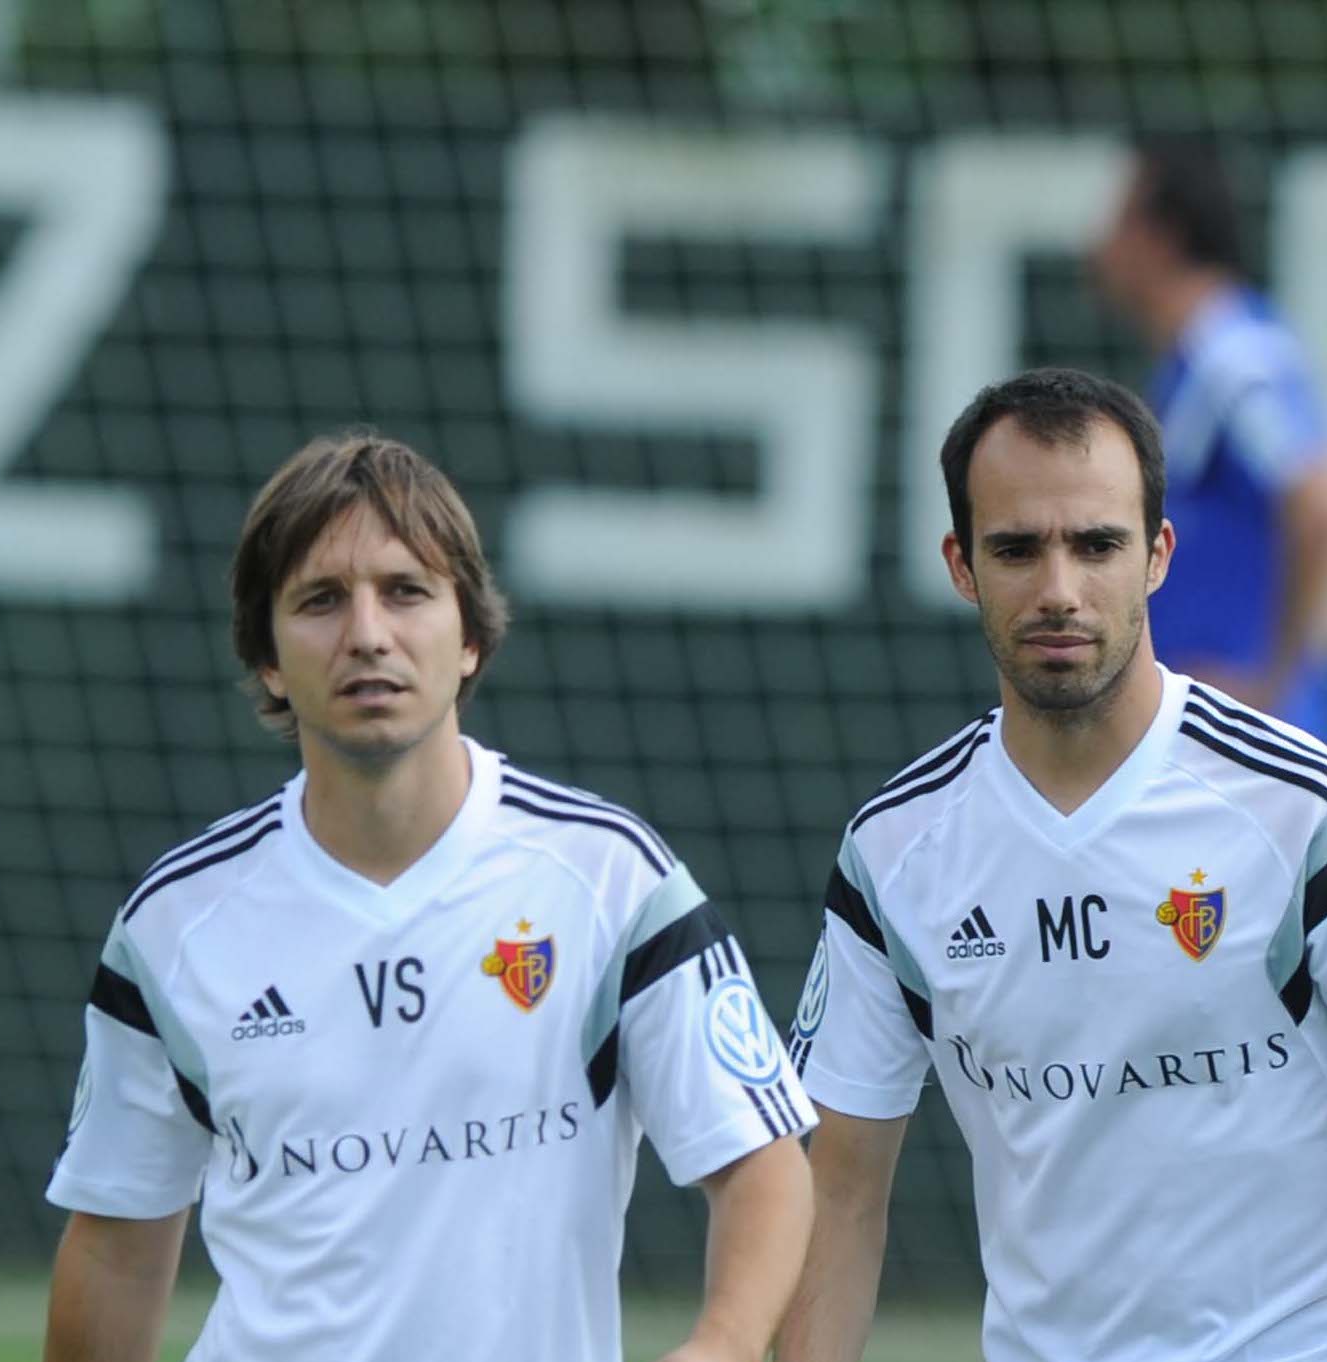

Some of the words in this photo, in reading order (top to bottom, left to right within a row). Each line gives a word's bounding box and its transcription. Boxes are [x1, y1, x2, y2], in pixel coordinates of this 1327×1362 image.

[946, 939, 1006, 959] adidas
[1036, 894, 1110, 962] MC
[354, 956, 426, 1028] VS
[231, 1019, 305, 1041] adidas
[1005, 1032, 1289, 1101] NOVARTIS
[281, 1101, 579, 1177] NOVARTIS
